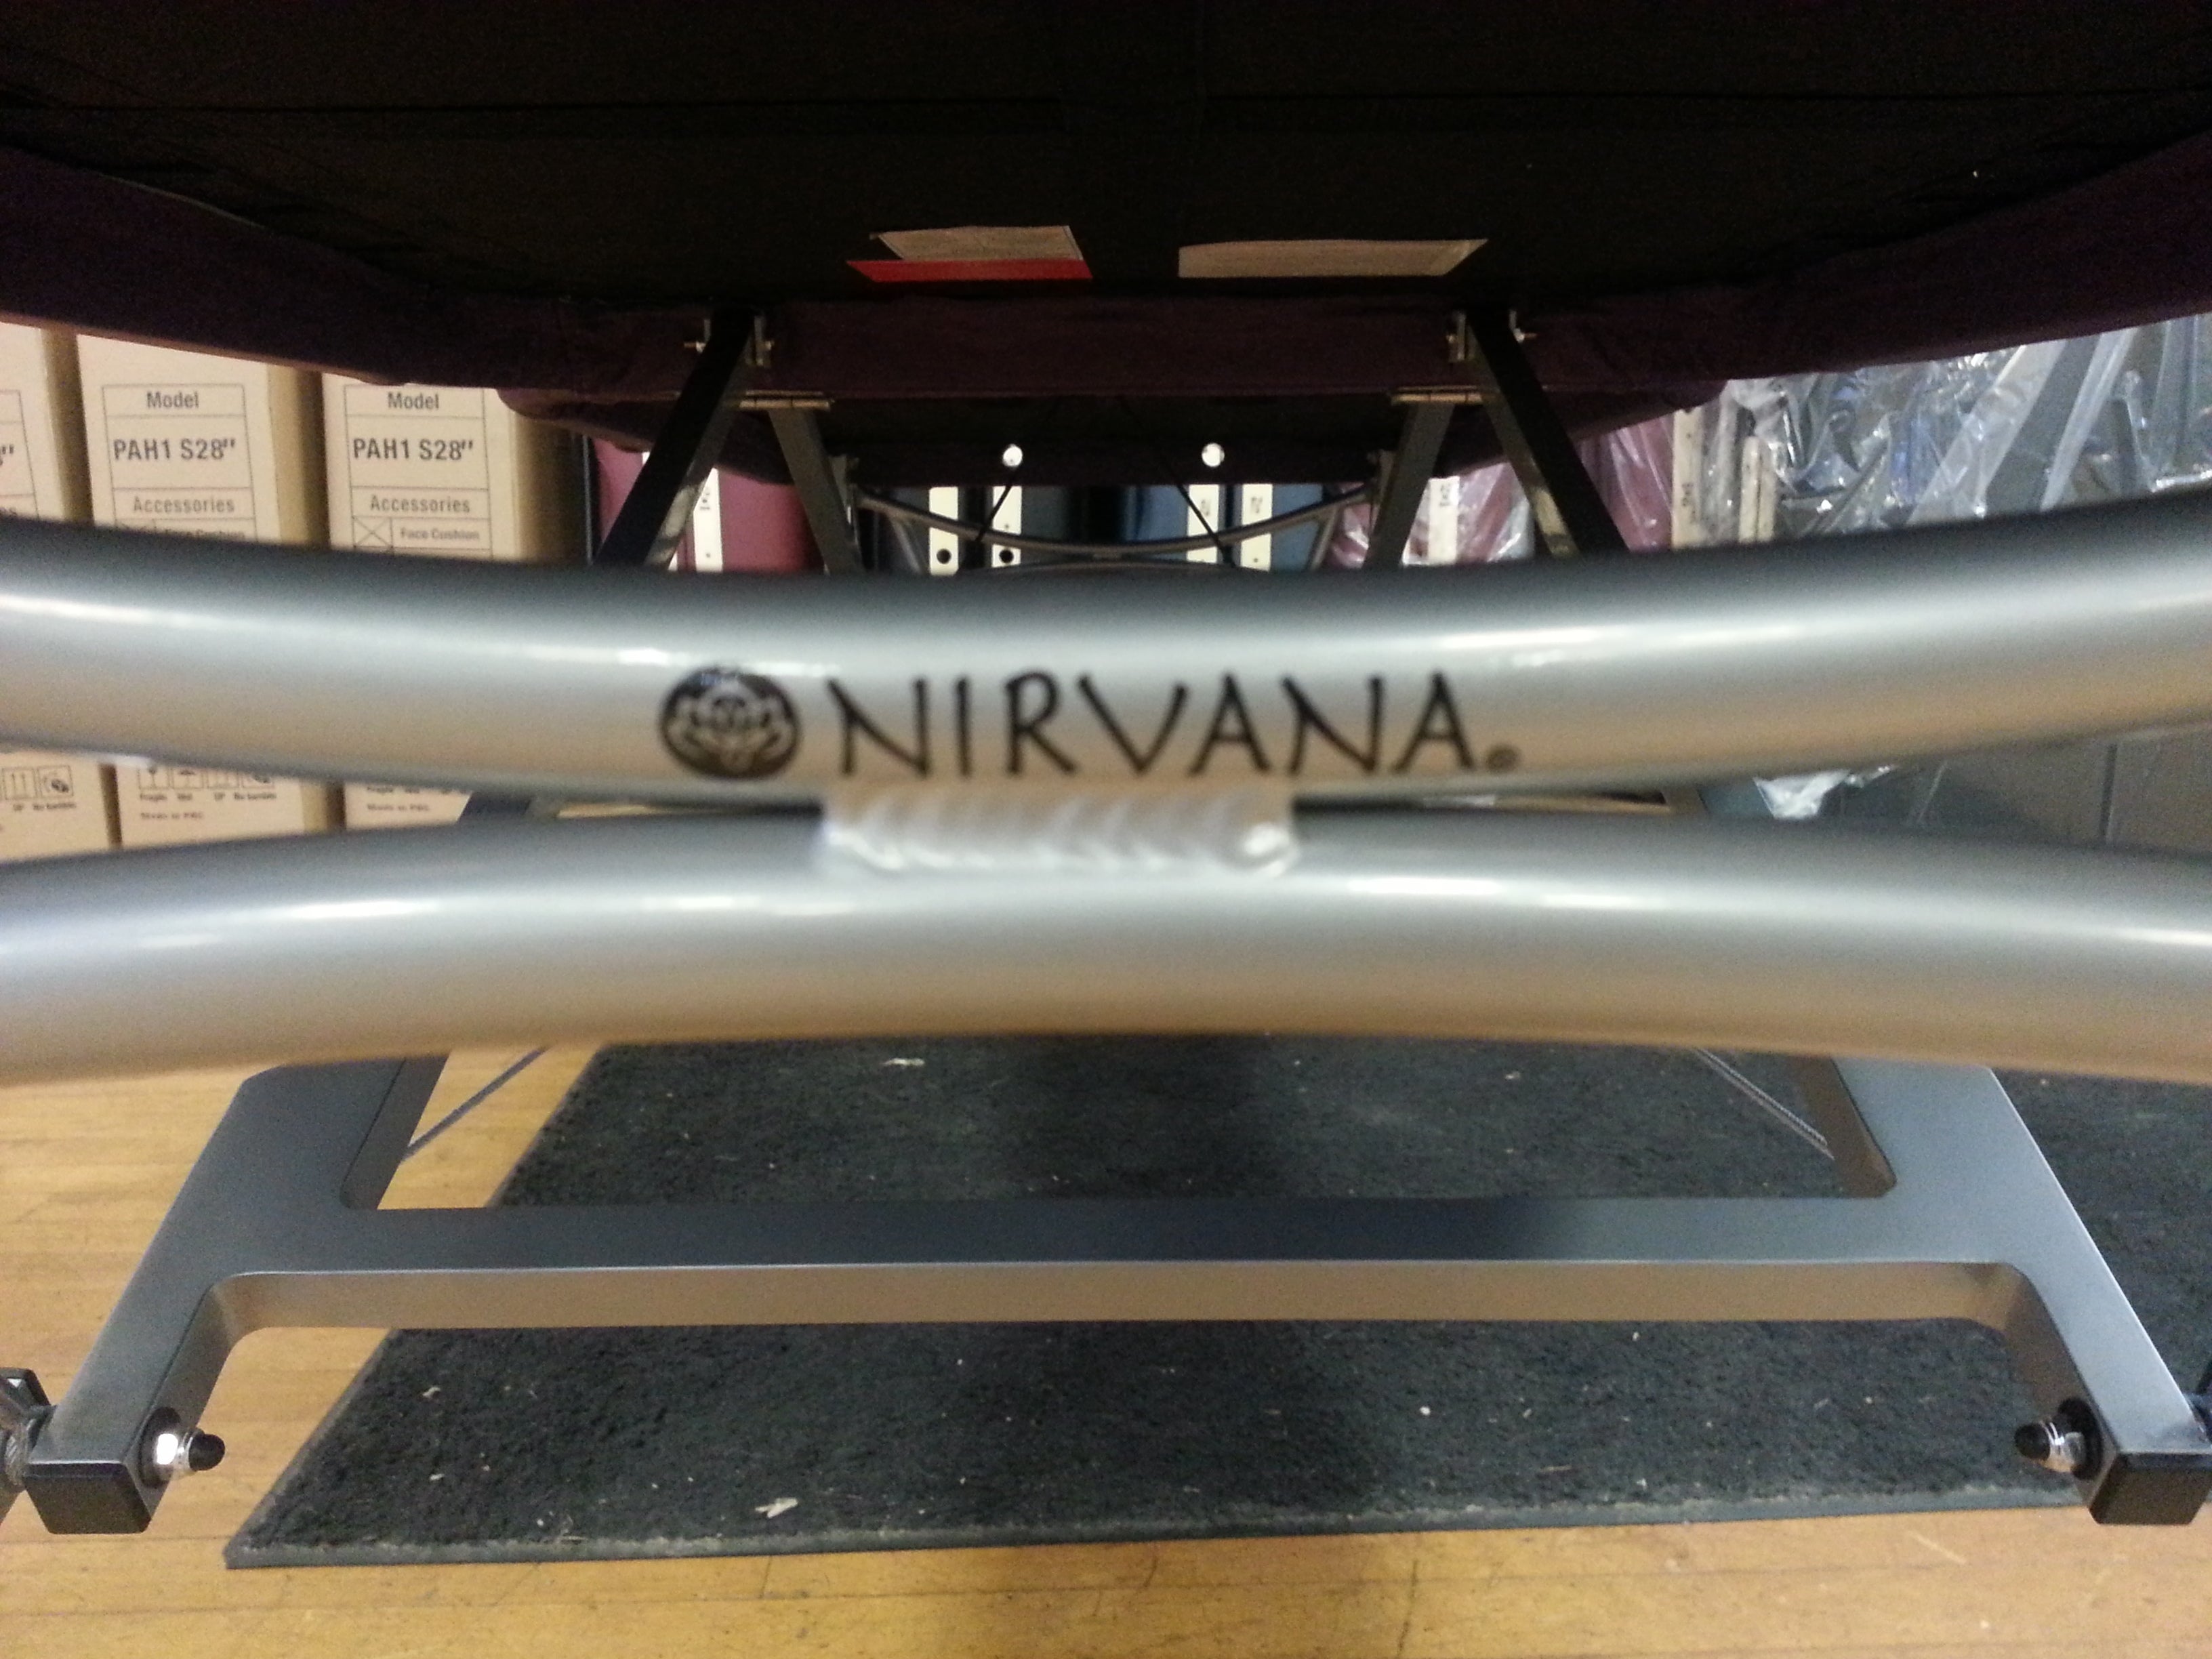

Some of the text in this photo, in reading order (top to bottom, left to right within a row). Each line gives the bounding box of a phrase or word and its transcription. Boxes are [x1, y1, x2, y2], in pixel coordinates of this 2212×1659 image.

[146, 390, 199, 409] Model
[387, 392, 440, 409] Model
[113, 438, 171, 461] PAH1
[353, 438, 410, 460] PAH1
[134, 495, 235, 514] Accessories
[371, 495, 470, 513] Accessories
[824, 671, 1477, 778] NIRVANA
